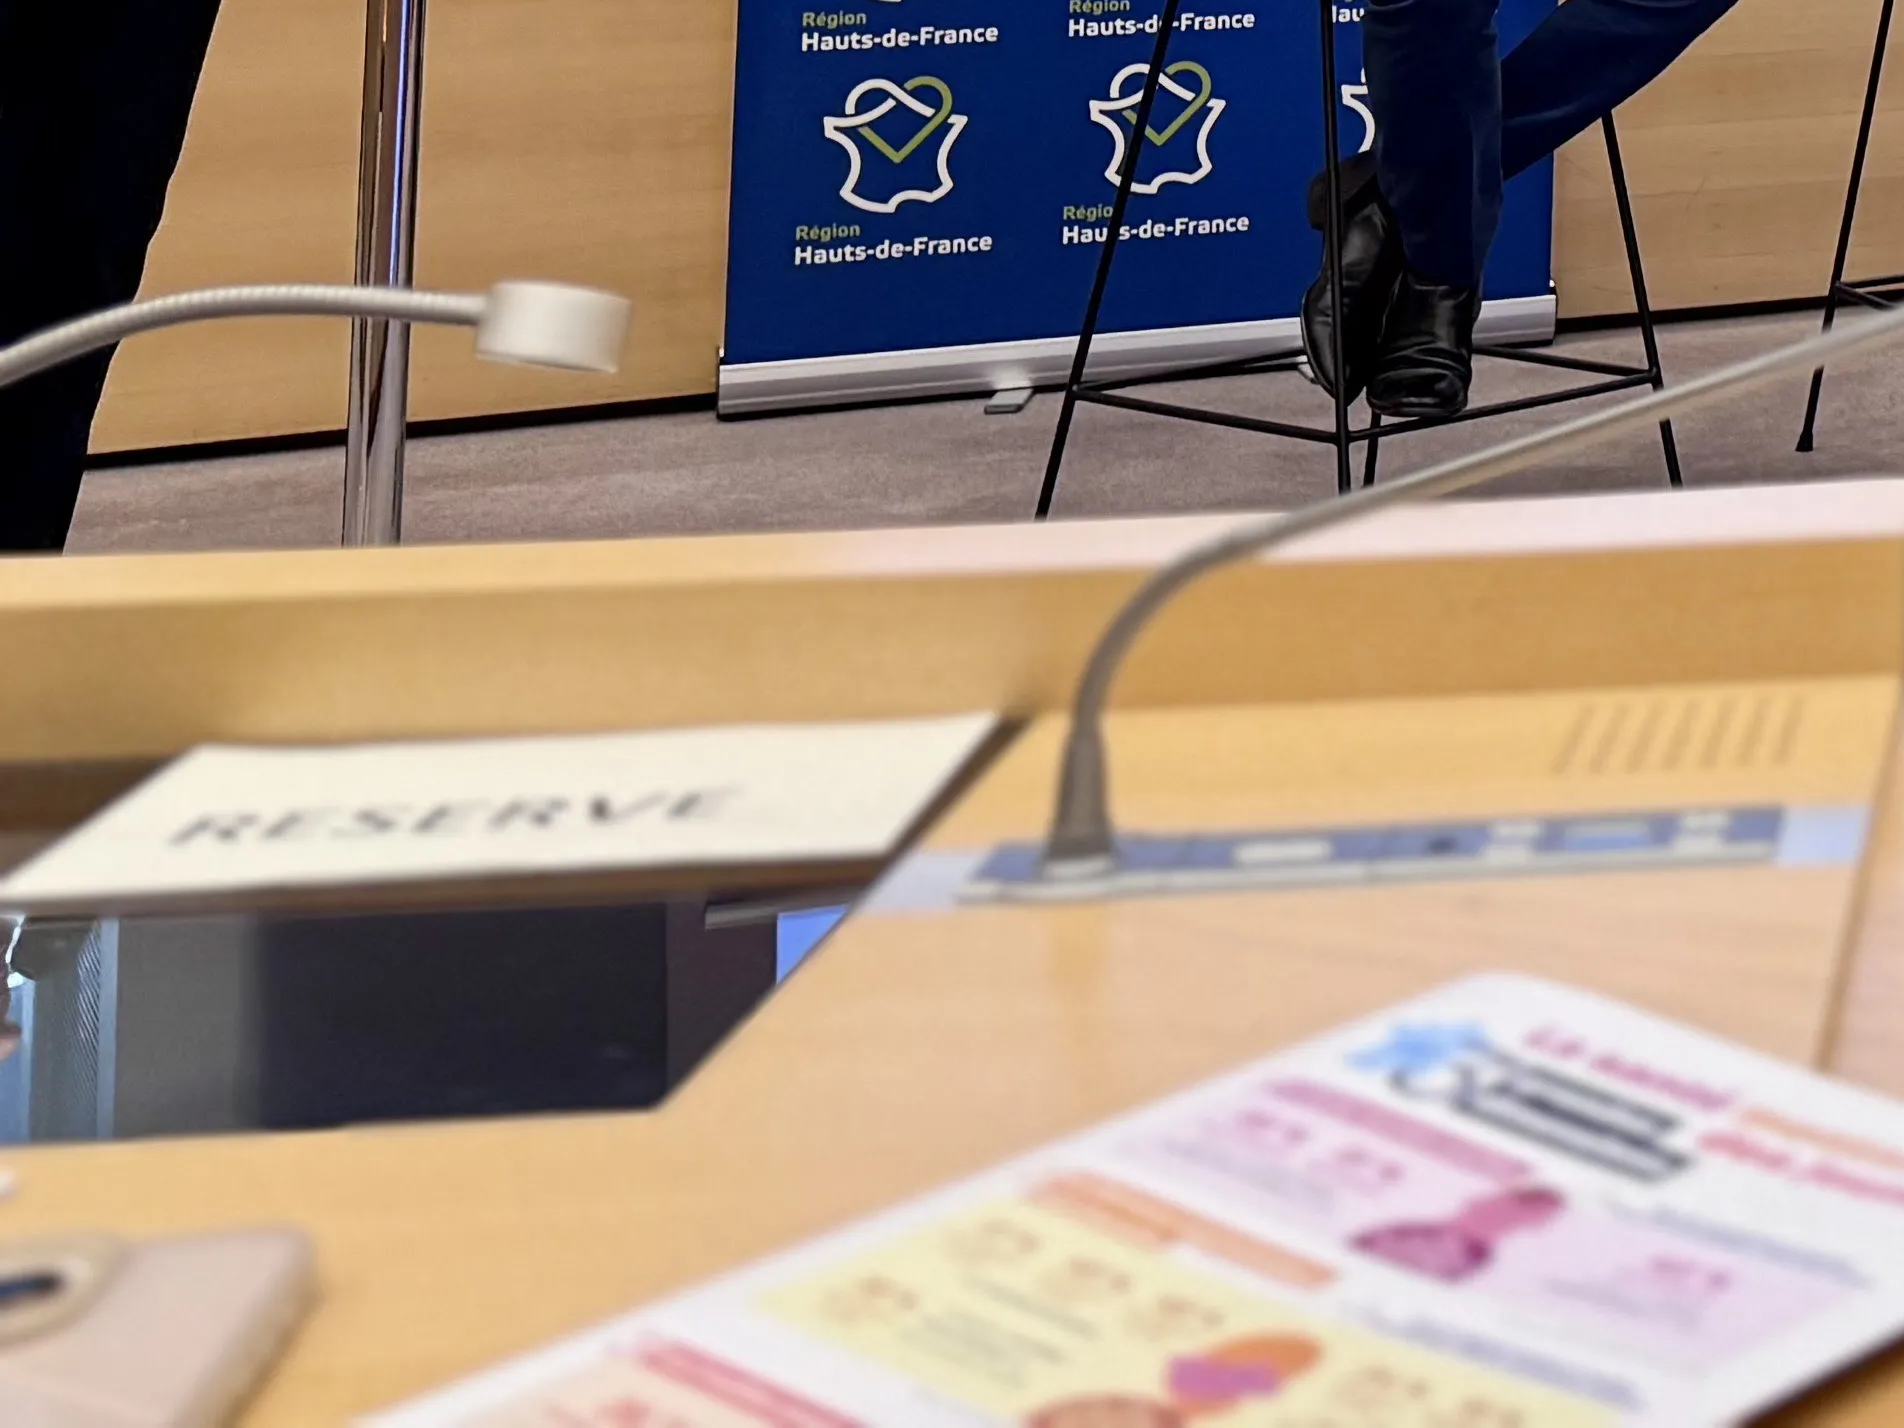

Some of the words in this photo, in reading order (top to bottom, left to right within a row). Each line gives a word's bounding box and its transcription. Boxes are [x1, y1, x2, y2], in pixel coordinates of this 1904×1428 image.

[802, 10, 867, 29] Région
[801, 25, 999, 52] Hauts-de-France
[1063, 202, 1113, 221] Régio
[796, 223, 861, 241] Région
[1062, 213, 1250, 245] Haus-de-France
[794, 234, 993, 266] Hauts-de-France
